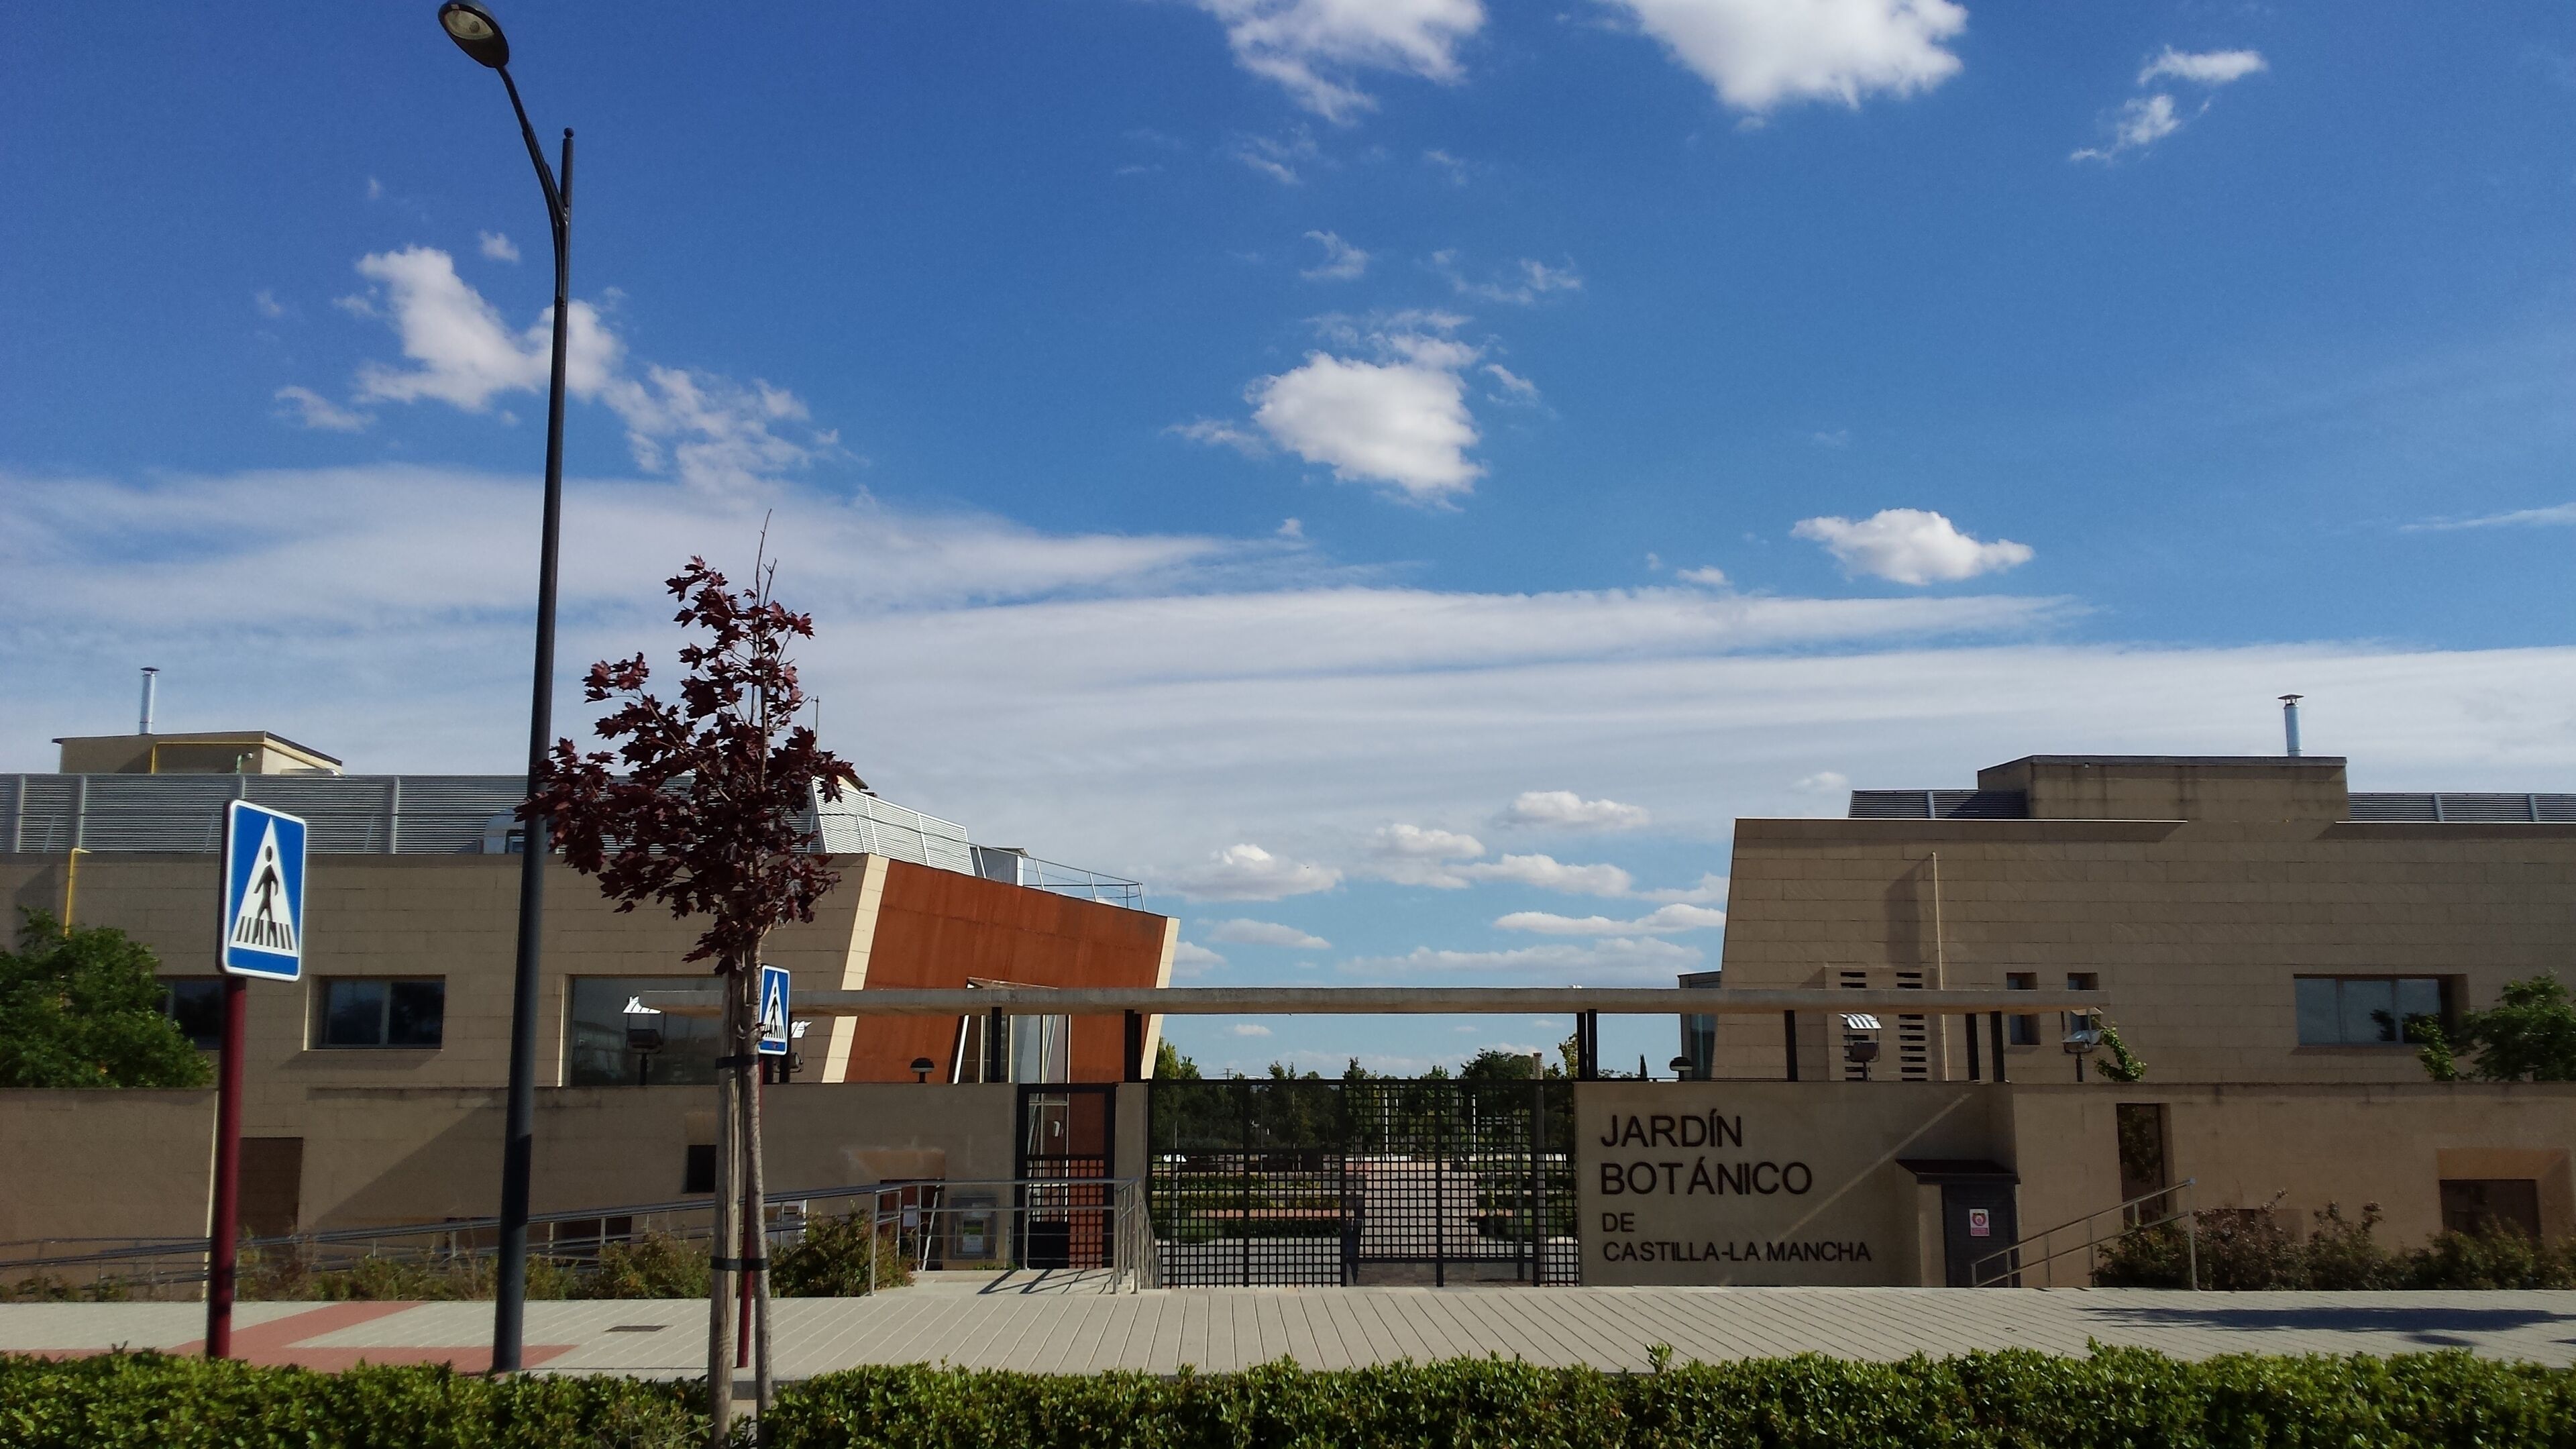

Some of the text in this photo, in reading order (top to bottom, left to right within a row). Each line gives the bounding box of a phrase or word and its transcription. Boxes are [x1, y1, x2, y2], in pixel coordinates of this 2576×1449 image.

[1600, 1108, 1743, 1148] JARDÍN
[1600, 1156, 1813, 1195] BOTÁNICO
[1602, 1212, 1635, 1232] DE
[1603, 1241, 1872, 1262] CASTILLA-LA MANCHA
